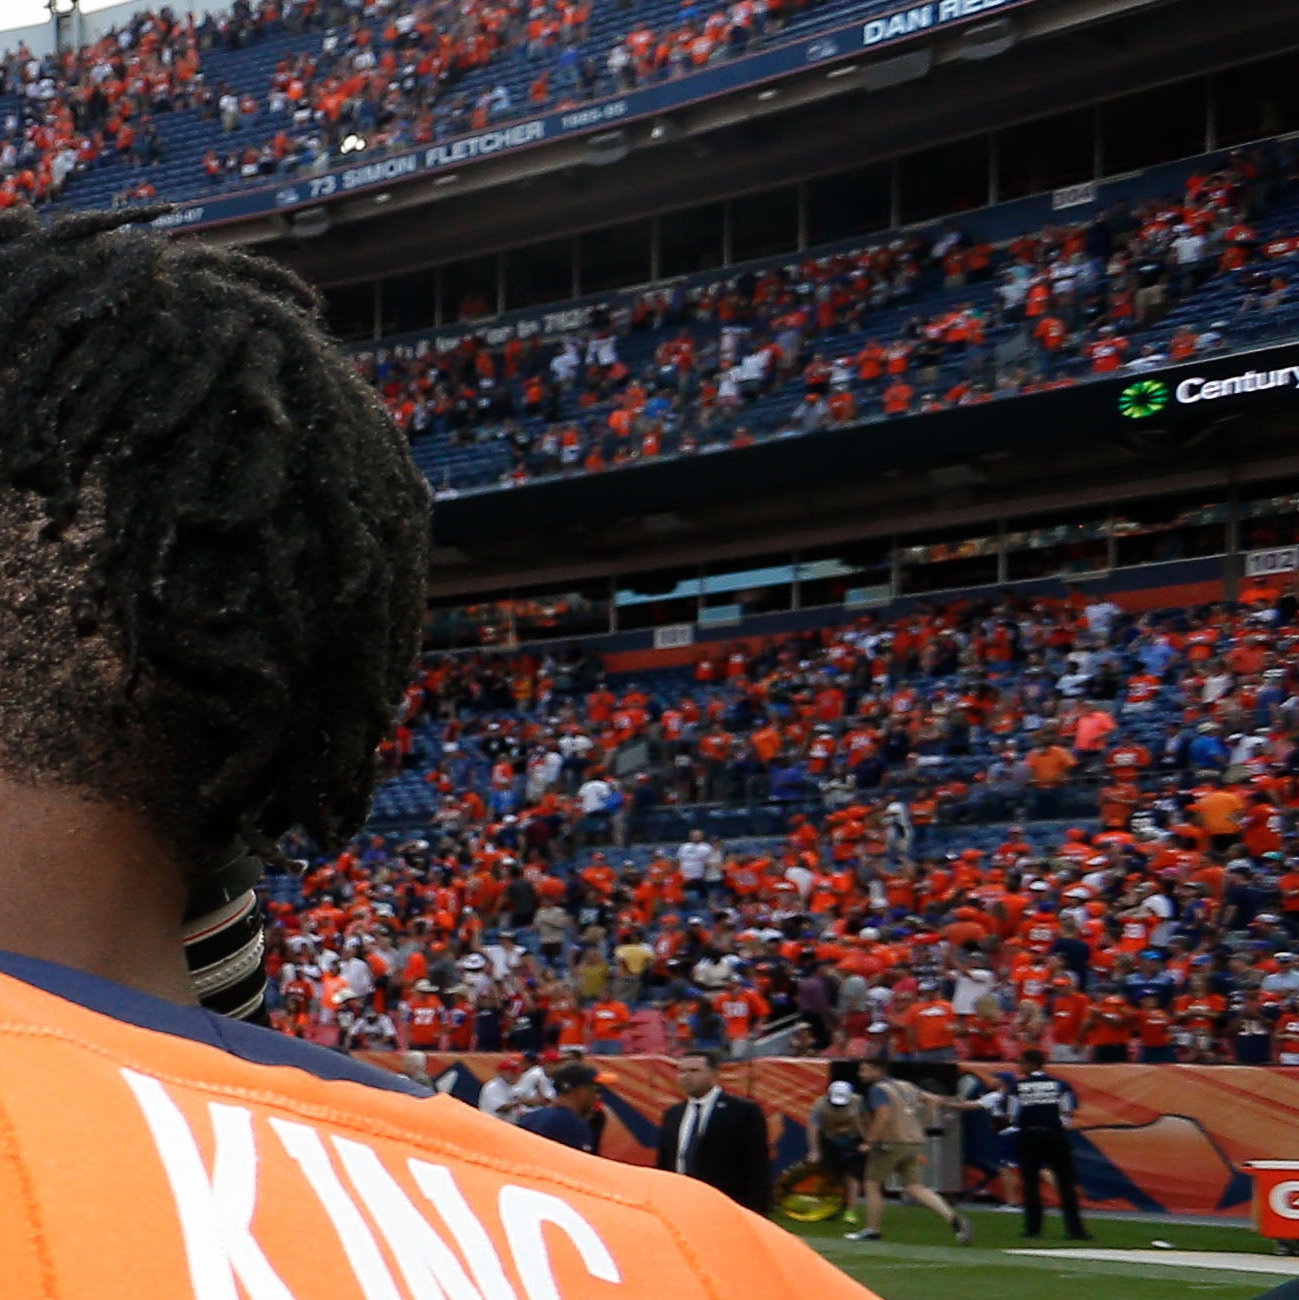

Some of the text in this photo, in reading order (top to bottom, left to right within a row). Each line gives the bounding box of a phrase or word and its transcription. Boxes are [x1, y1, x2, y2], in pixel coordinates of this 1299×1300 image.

[863, 4, 933, 45] DAN
[309, 176, 336, 198] 73
[342, 154, 417, 188] SIMON
[425, 121, 545, 167] FLETCHER
